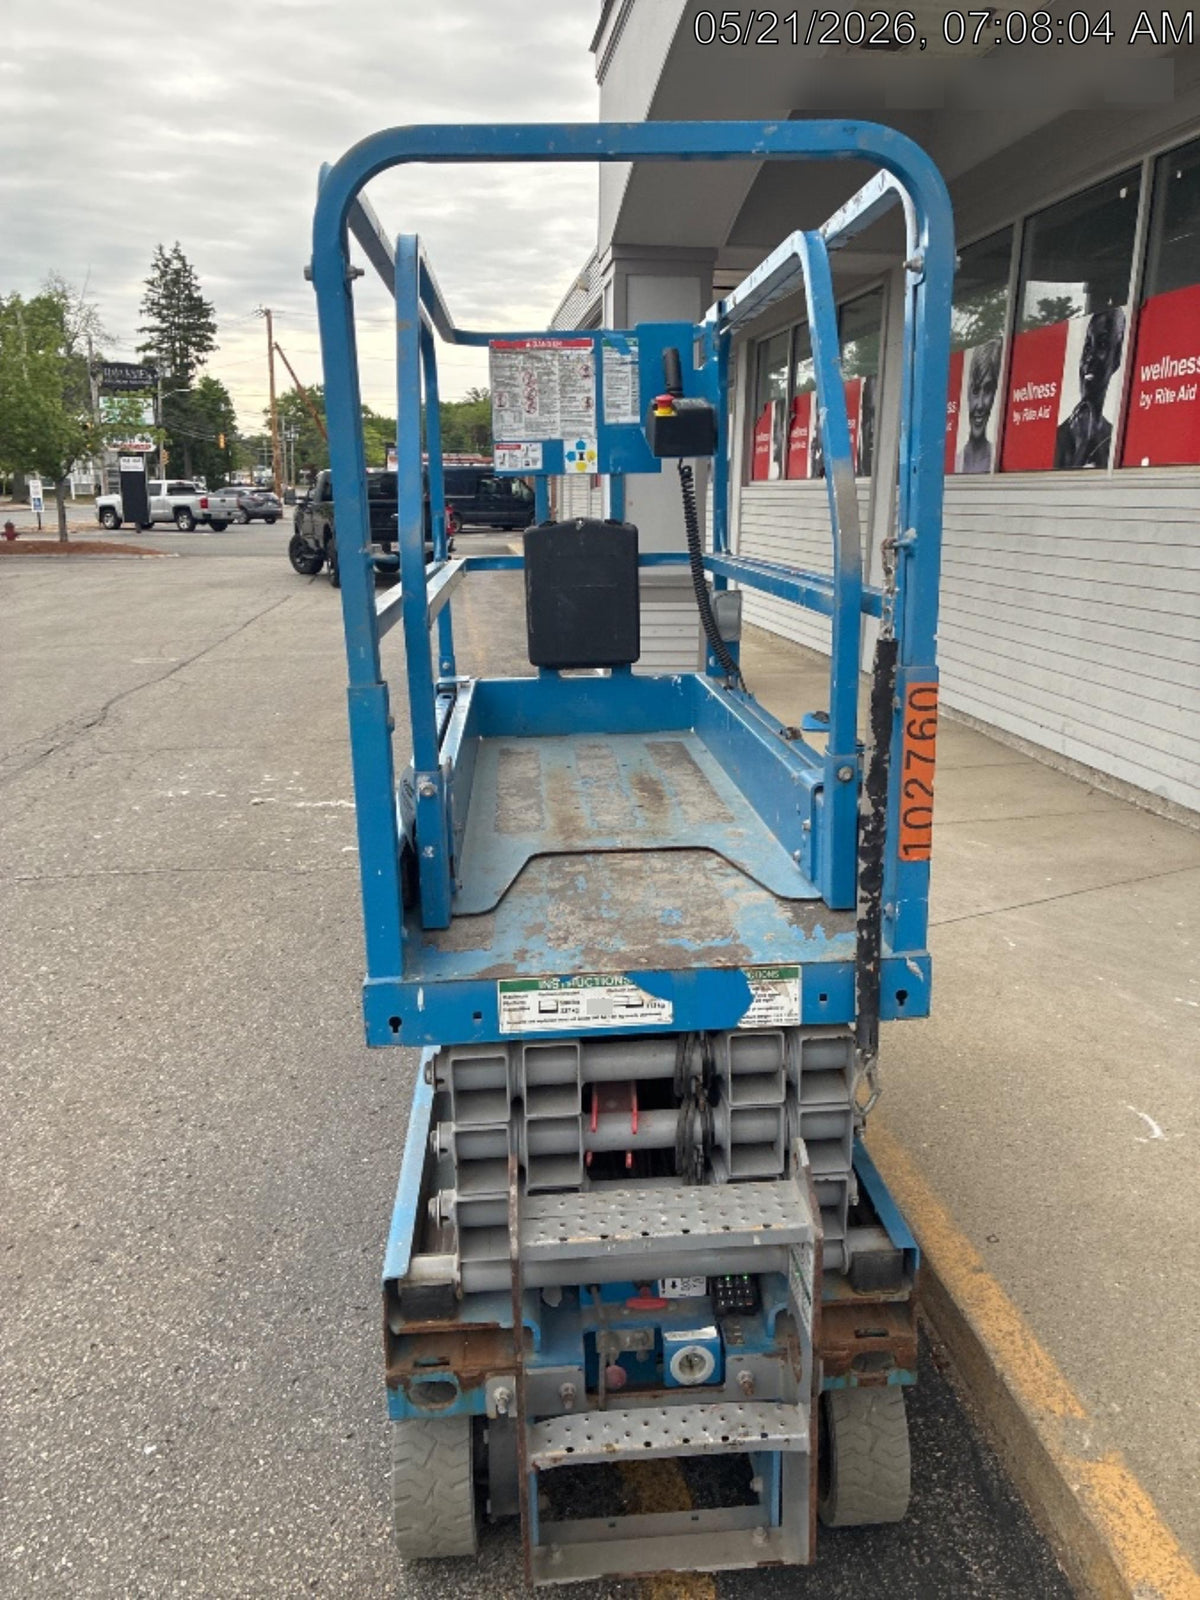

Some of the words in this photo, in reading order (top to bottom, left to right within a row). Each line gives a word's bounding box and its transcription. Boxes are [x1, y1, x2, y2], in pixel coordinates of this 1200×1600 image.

[1013, 381, 1057, 402] wellness
[1139, 391, 1152, 410] by
[1155, 387, 1176, 404] Rite
[1177, 383, 1198, 402] Aid
[1013, 410, 1021, 425] by
[1022, 407, 1037, 421] Rite
[1038, 404, 1052, 419] Aid
[903, 687, 938, 856] 102760
